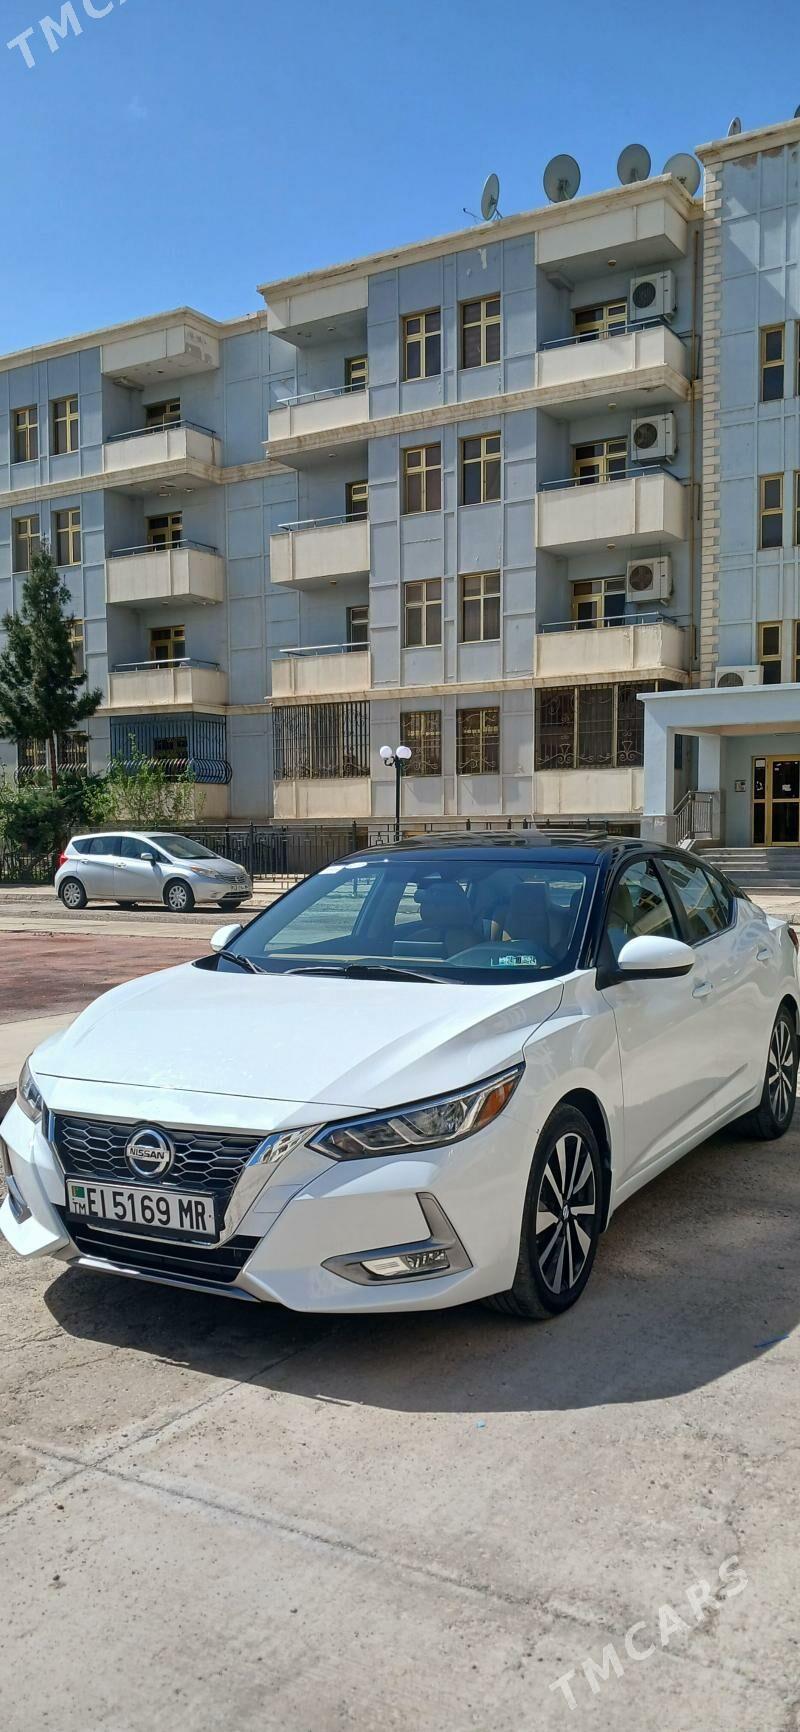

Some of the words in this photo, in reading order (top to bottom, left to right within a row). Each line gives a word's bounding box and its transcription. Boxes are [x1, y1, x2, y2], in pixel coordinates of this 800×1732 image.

[129, 1147, 165, 1160] NISSAN
[73, 1201, 86, 1213] TM
[112, 1191, 171, 1226] 5169
[178, 1198, 207, 1231] MR
